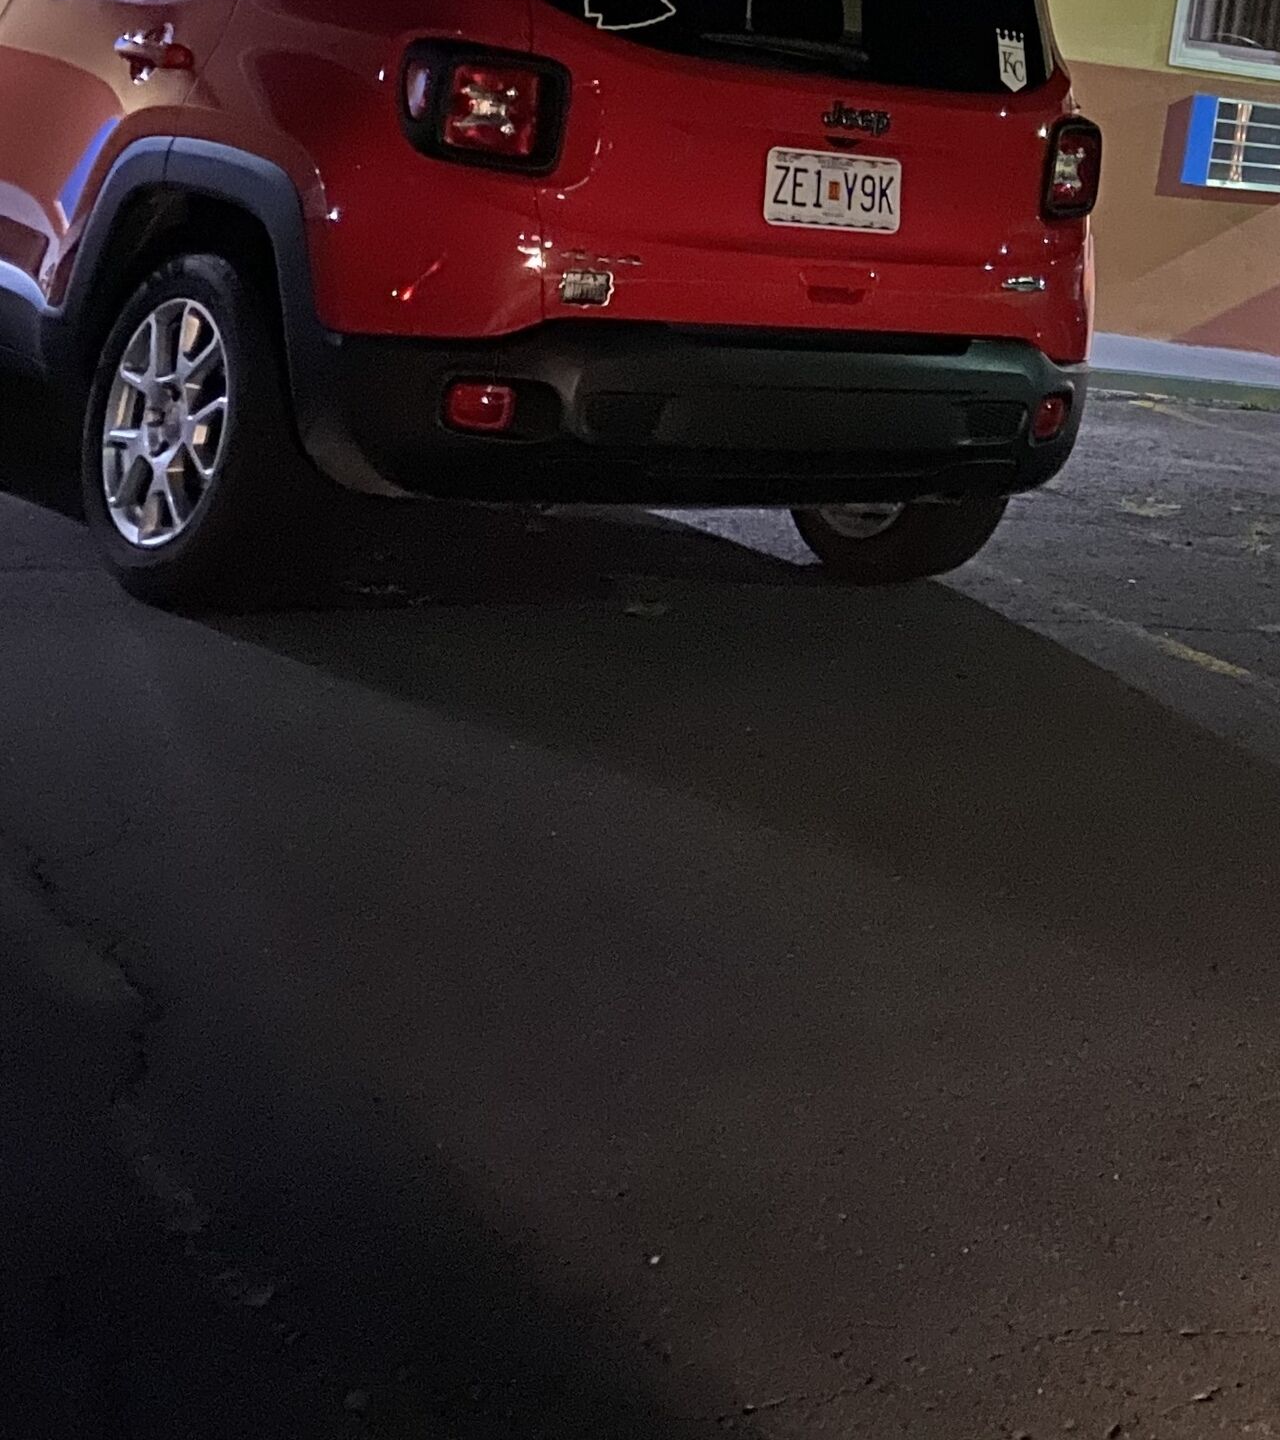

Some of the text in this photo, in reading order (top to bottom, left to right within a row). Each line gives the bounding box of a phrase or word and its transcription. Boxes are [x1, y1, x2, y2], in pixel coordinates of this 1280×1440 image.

[1002, 51, 1025, 82] KC
[820, 100, 891, 138] Jeep
[773, 165, 895, 215] ZE1 Y9K
